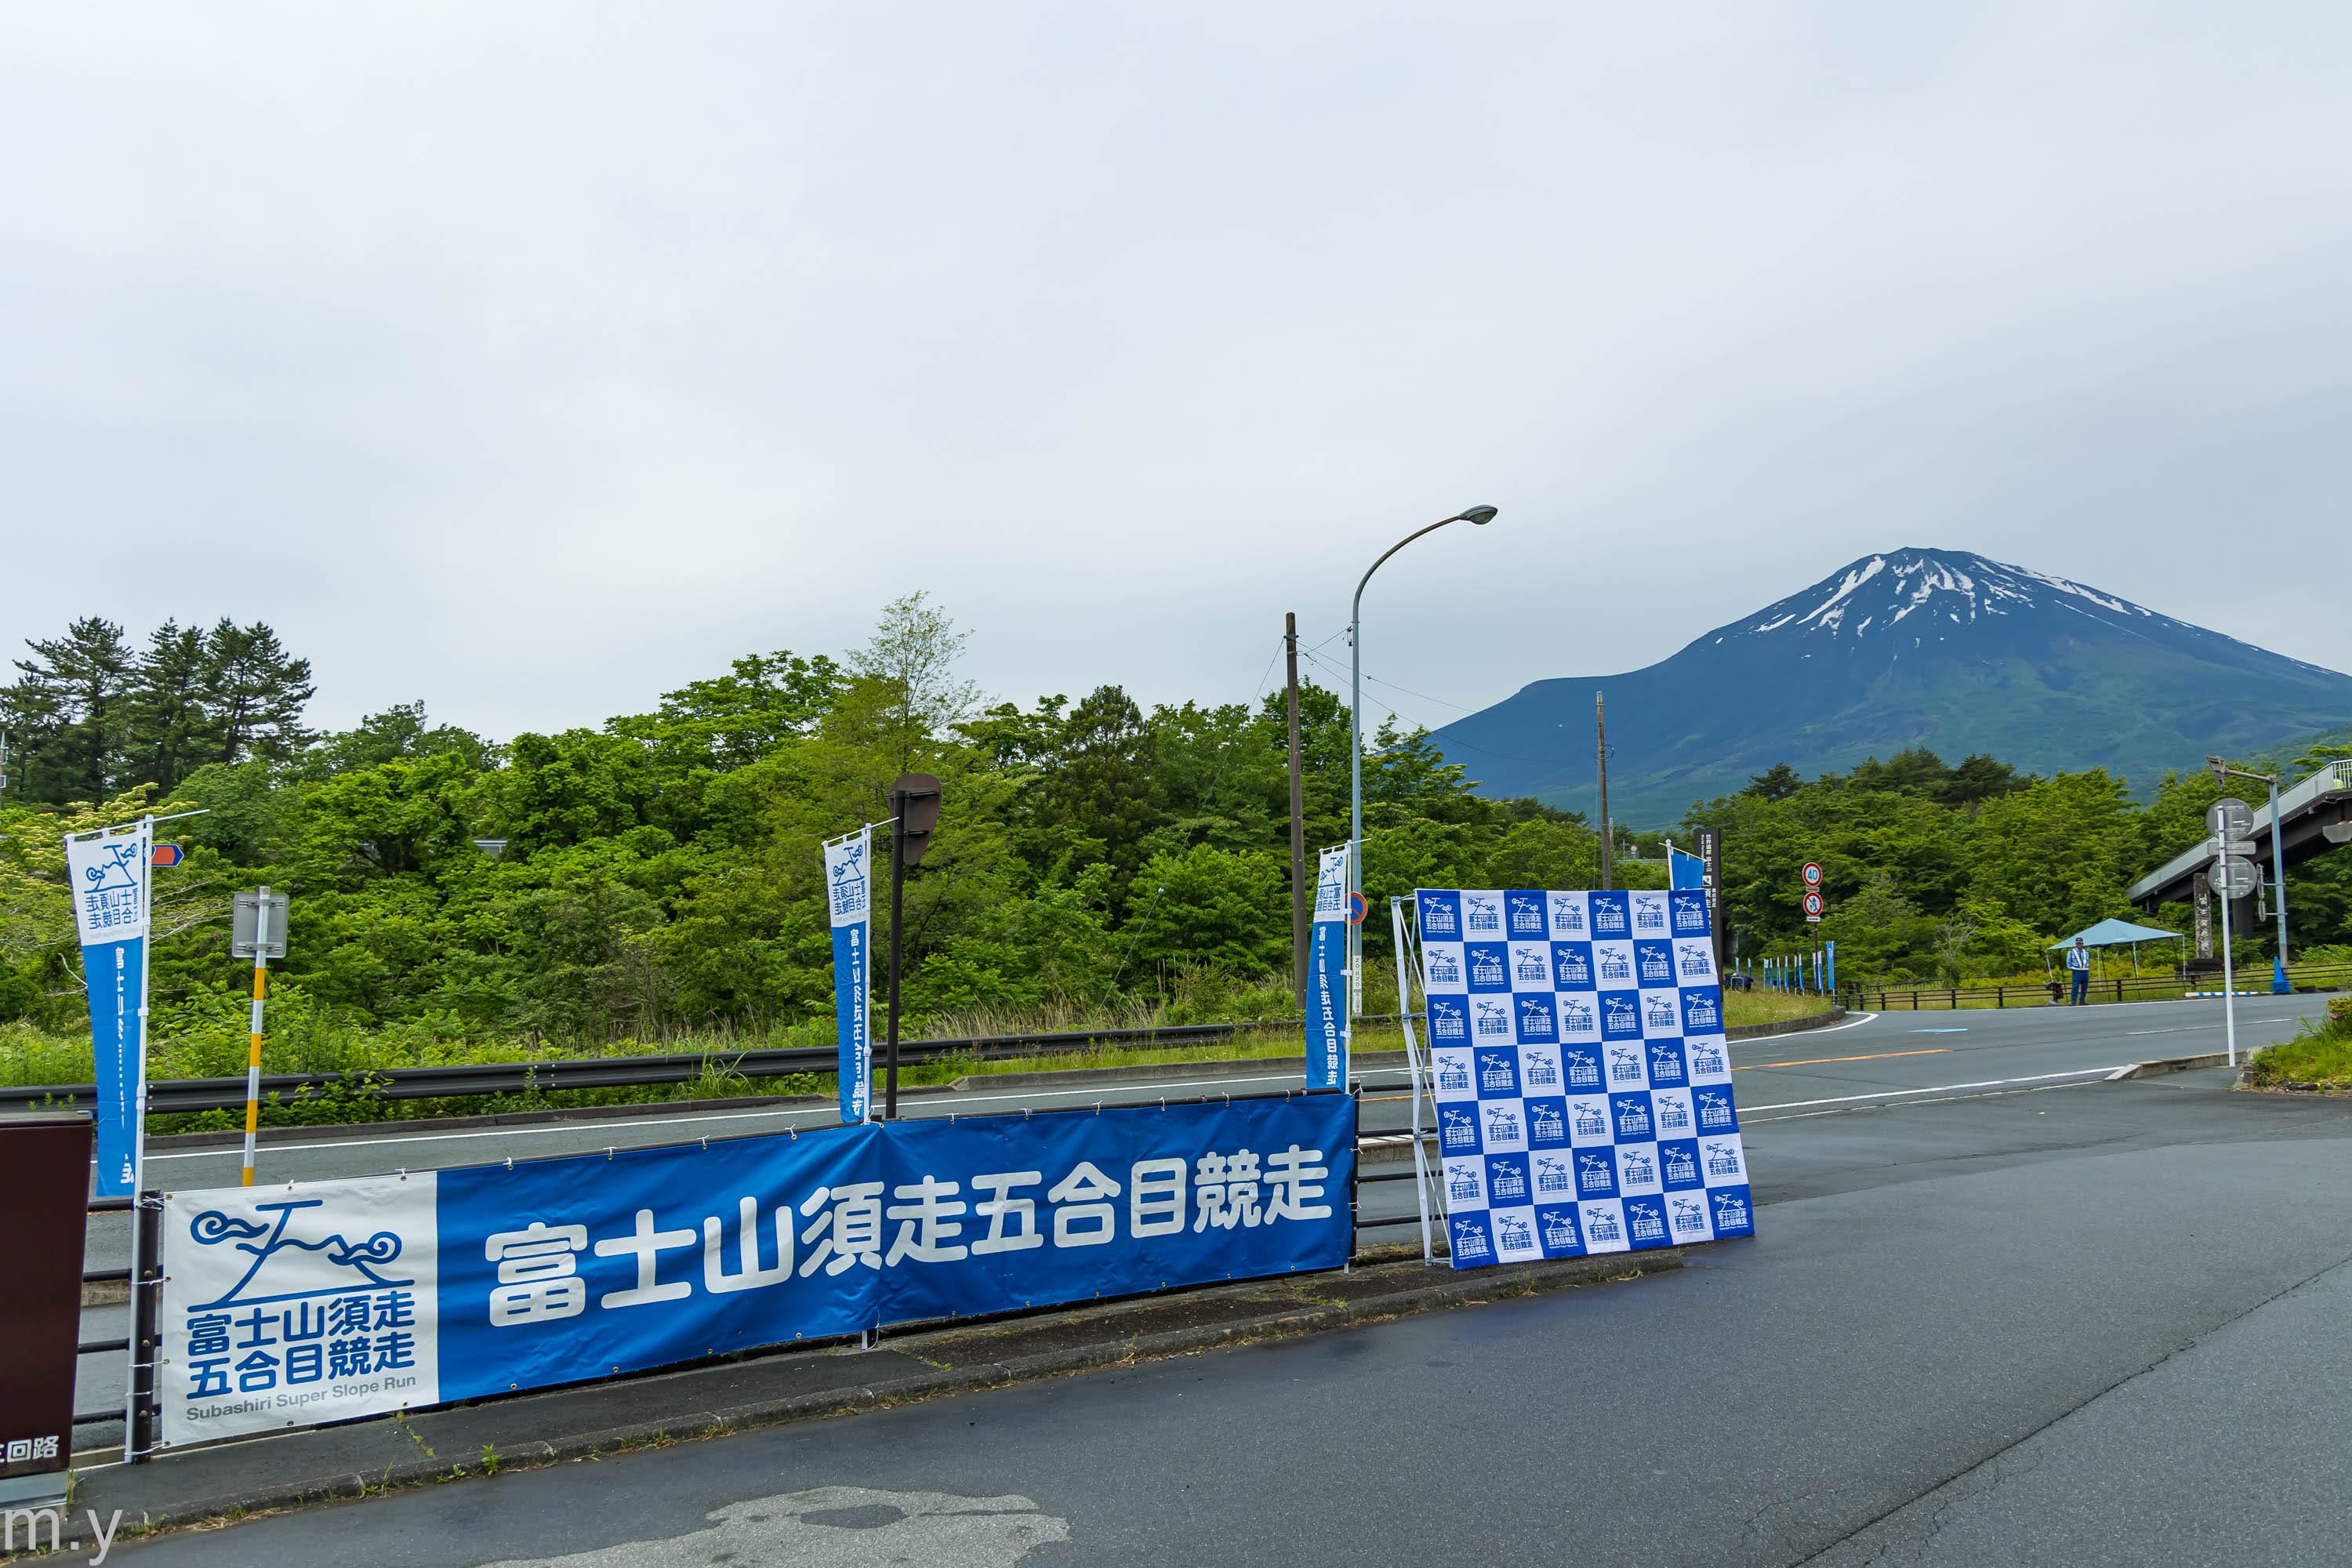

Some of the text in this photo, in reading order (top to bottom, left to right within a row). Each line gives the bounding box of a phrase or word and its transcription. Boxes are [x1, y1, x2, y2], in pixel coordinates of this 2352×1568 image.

[1807, 869, 1818, 880] 40
[1681, 960, 1710, 969] 富士山須走
[1606, 1014, 1636, 1022] 富士山須走
[1687, 1009, 1717, 1018] 富士山須走
[1435, 1020, 1464, 1029] 富士山須走
[1523, 1017, 1552, 1025] 富士山須走
[1653, 1062, 1681, 1071] 富士山須走
[1693, 1058, 1723, 1068] 富士山須走
[1527, 1069, 1556, 1078] 富士山須走
[1612, 1065, 1641, 1073] 富士山須走
[1439, 1073, 1468, 1082] 富士山須走
[1483, 1072, 1513, 1080] 富士山須走
[1661, 1112, 1688, 1121] 富士山須走
[1700, 1109, 1731, 1118] 富士山須走
[1576, 1119, 1605, 1128] 富士山須走
[1619, 1116, 1649, 1125] 富士山須走
[1488, 1124, 1519, 1134] 富士山須走
[1534, 1122, 1563, 1131] 富士山須走
[1445, 1127, 1475, 1137] 富士山須走
[1666, 1163, 1695, 1174] 富士山須走
[1708, 1159, 1738, 1169] 富士山須走
[1581, 1171, 1611, 1181] 富士山須走
[1624, 1167, 1653, 1178] 富士山須走
[1494, 1178, 1524, 1189] 富士山須走
[1538, 1174, 1568, 1184] 富士山須走
[1450, 1182, 1479, 1192] 富士山須走
[1675, 1214, 1704, 1225] 富士山須走
[1717, 1210, 1747, 1220] 富士山須走
[1589, 1225, 1619, 1234] 富士山須走
[1632, 1220, 1663, 1230] 富士山須走
[485, 1145, 1332, 1327] 富士山須走五合目競走
[1501, 1232, 1531, 1243] 富士山須走
[1545, 1229, 1577, 1239] 富士山須走
[1457, 1237, 1486, 1249] 富士山須走
[187, 1290, 416, 1356] 富士山須走
[187, 1331, 416, 1399] 五合目競走
[187, 1376, 416, 1421] Subashiri Super Slope Run
[0, 1436, 59, 1463] 回路
